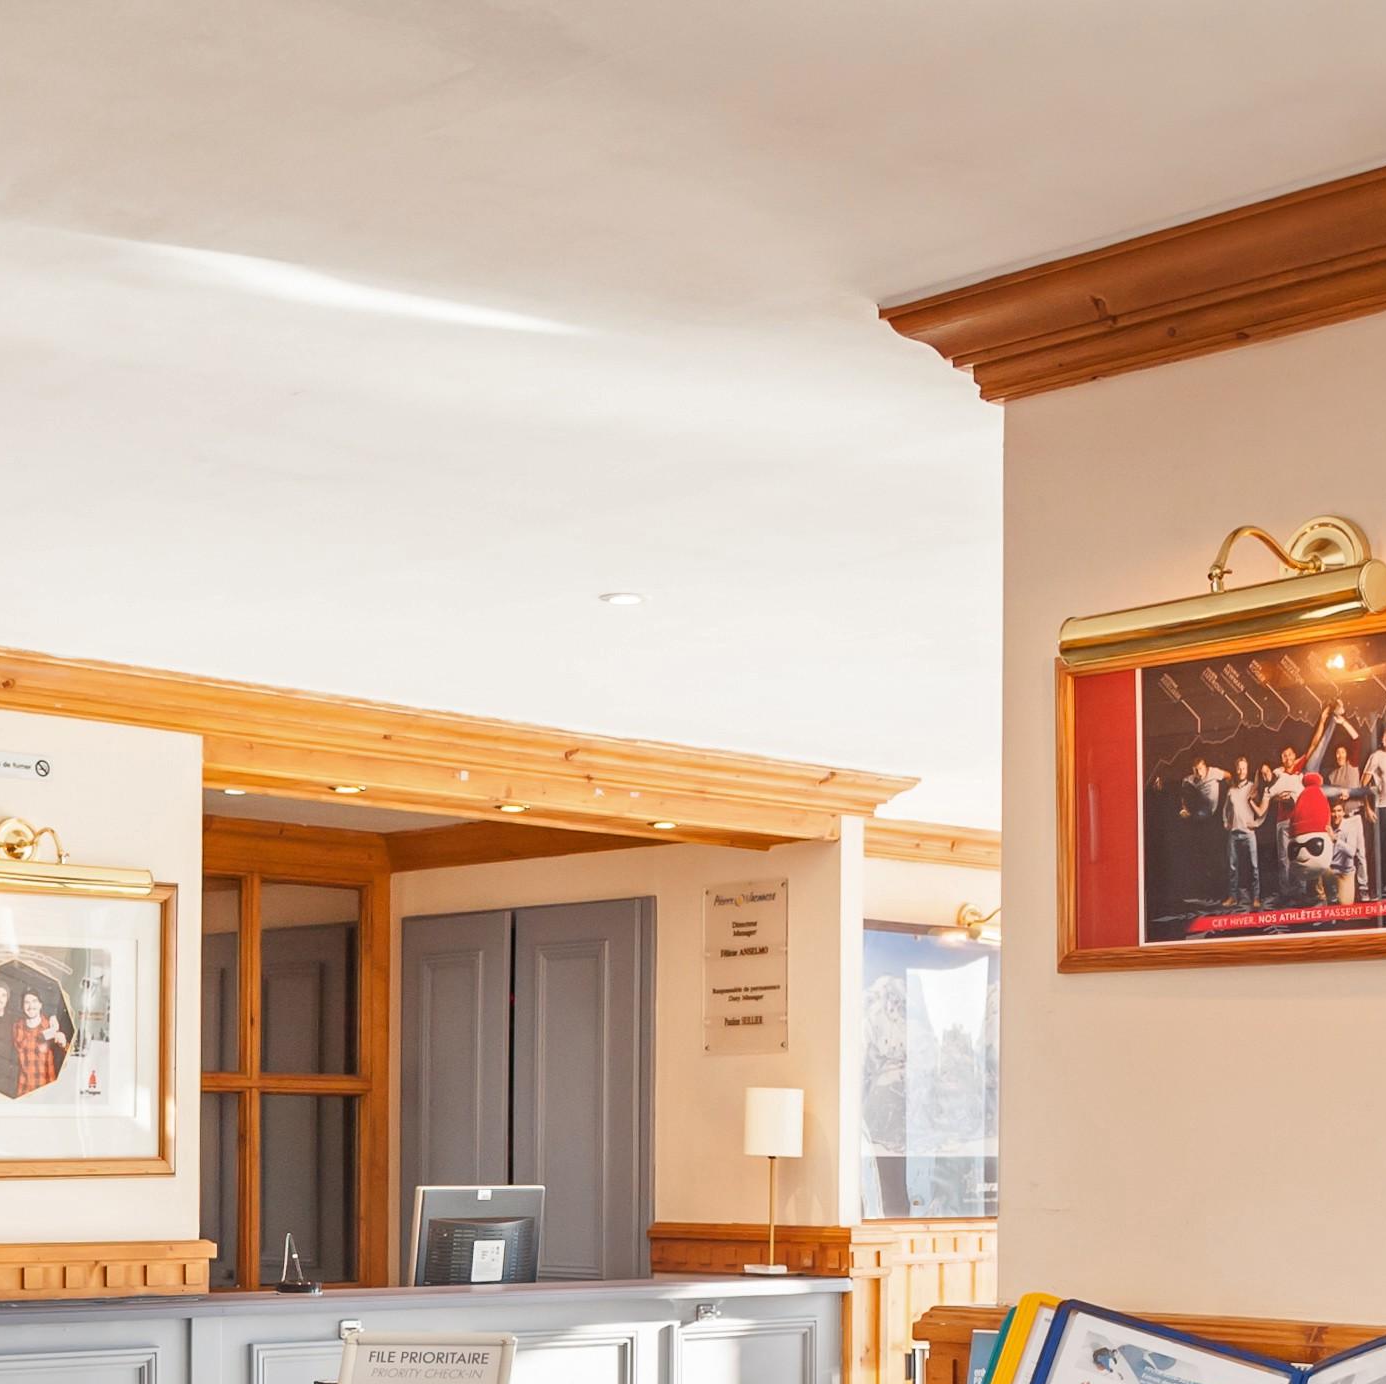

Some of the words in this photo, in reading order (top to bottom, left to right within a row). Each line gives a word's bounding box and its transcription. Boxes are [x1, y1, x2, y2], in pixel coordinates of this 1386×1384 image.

[1212, 919, 1228, 928] CET
[1258, 914, 1277, 924] NOS
[1325, 906, 1362, 917] PASSENT
[1366, 906, 1377, 914] EN
[368, 1351, 396, 1363] FILE
[401, 1351, 490, 1365] PRIORITAIRE
[371, 1367, 422, 1379] PRIORITY
[424, 1368, 484, 1380] CHECK-IN
